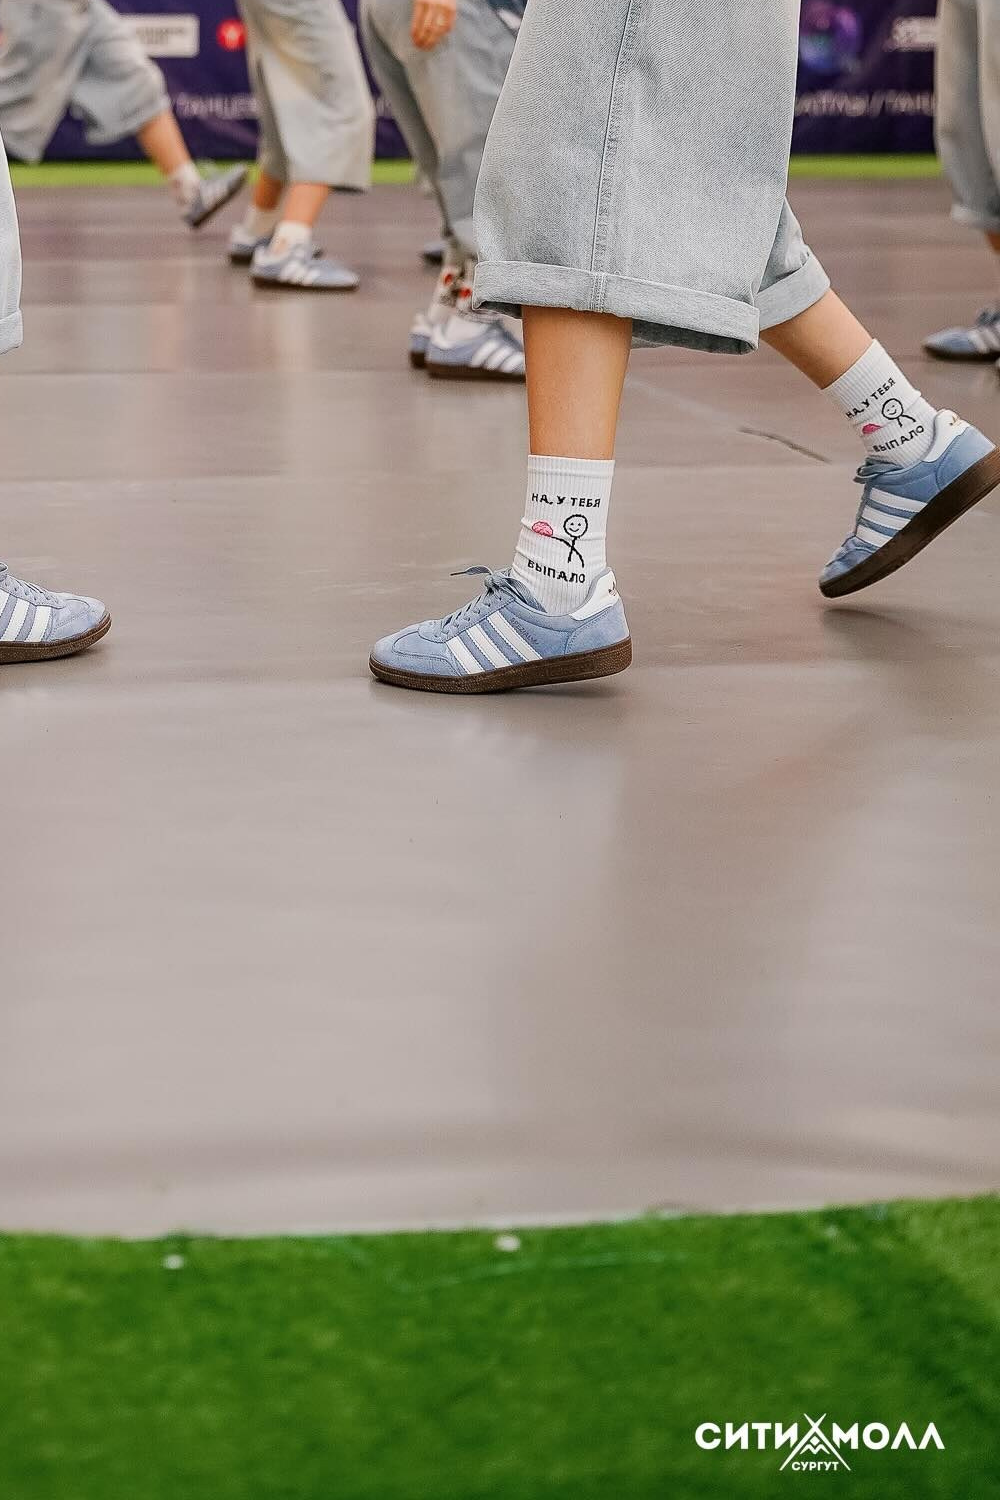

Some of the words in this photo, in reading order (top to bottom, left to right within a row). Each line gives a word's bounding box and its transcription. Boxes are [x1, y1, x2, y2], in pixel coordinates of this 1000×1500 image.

[870, 377, 896, 401] ТЕБЯ
[872, 425, 925, 453] ВЫПАЛО
[556, 496, 566, 505] У
[570, 497, 601, 508] ТЕБЯ
[527, 558, 586, 584] ВЫПАЛО
